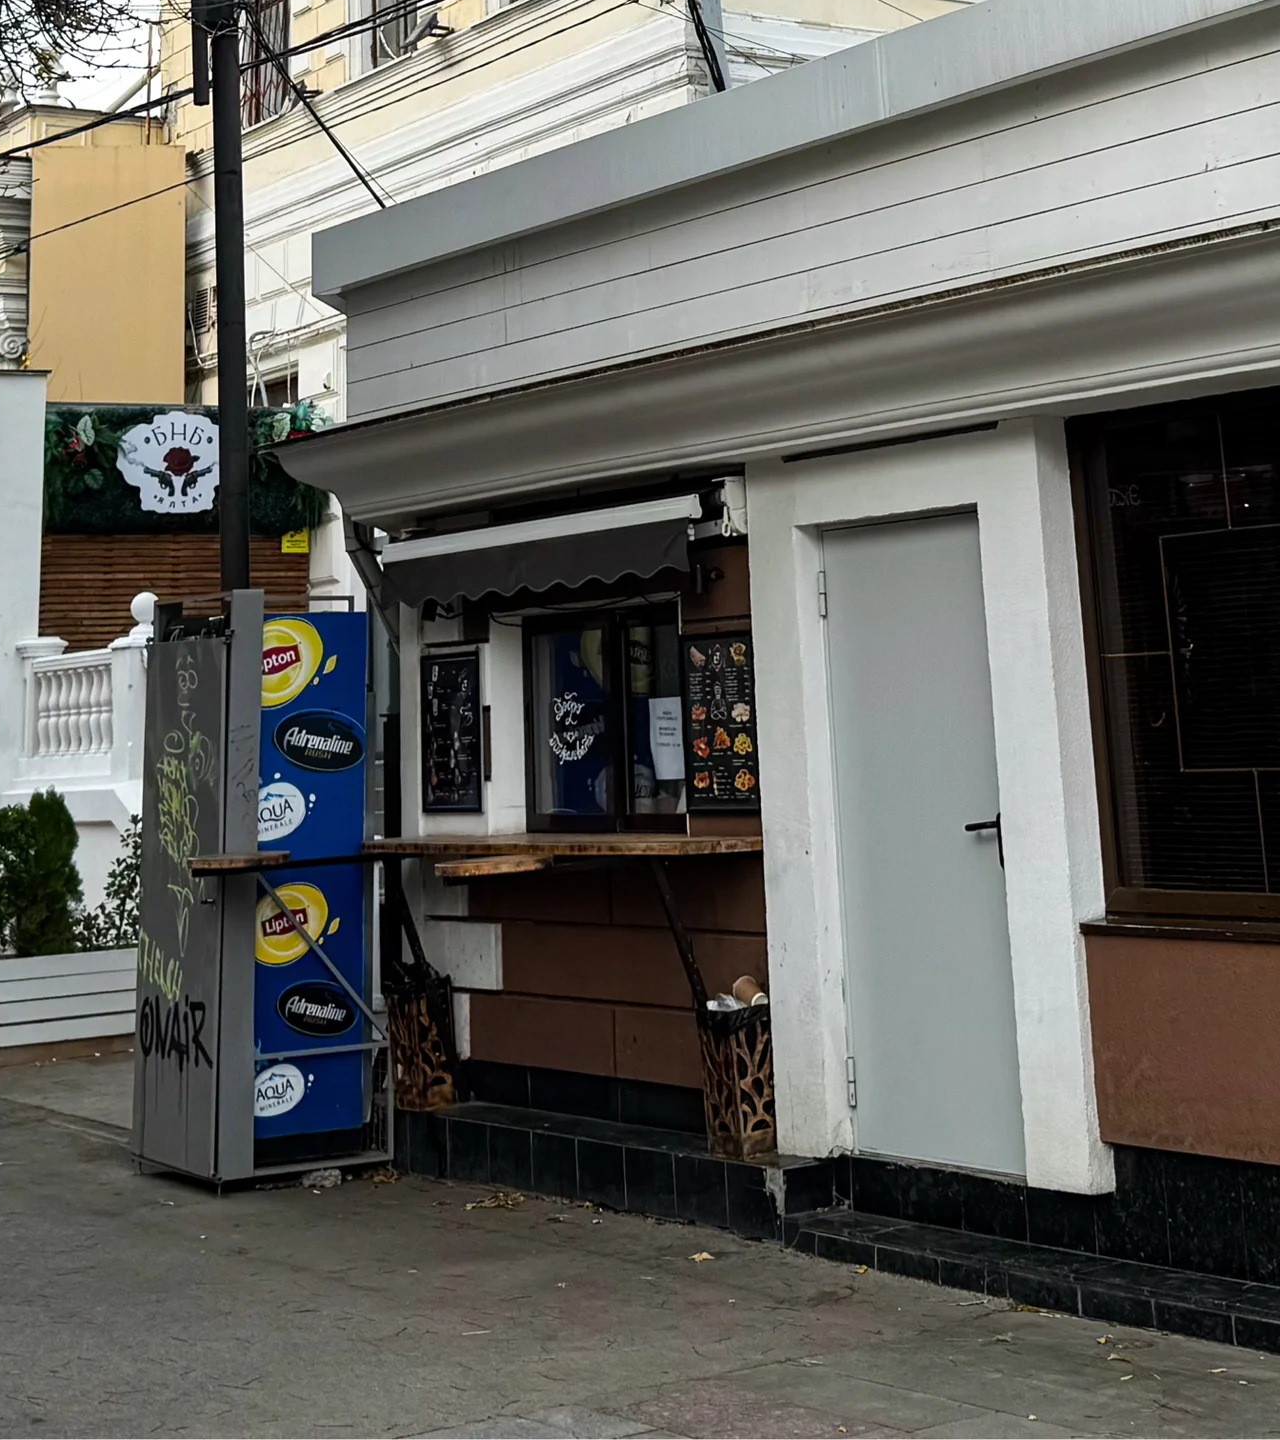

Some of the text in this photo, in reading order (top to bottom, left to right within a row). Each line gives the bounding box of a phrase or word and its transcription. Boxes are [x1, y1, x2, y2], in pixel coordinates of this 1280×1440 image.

[151, 422, 205, 447] БНБ
[157, 496, 199, 509] ЯЛТА
[261, 650, 296, 672] pton
[283, 727, 354, 756] Adrenaline
[304, 749, 332, 760] RUSH
[265, 913, 305, 934] Liptn
[285, 995, 347, 1022] Adrenaline
[255, 1080, 295, 1103] AQUA
